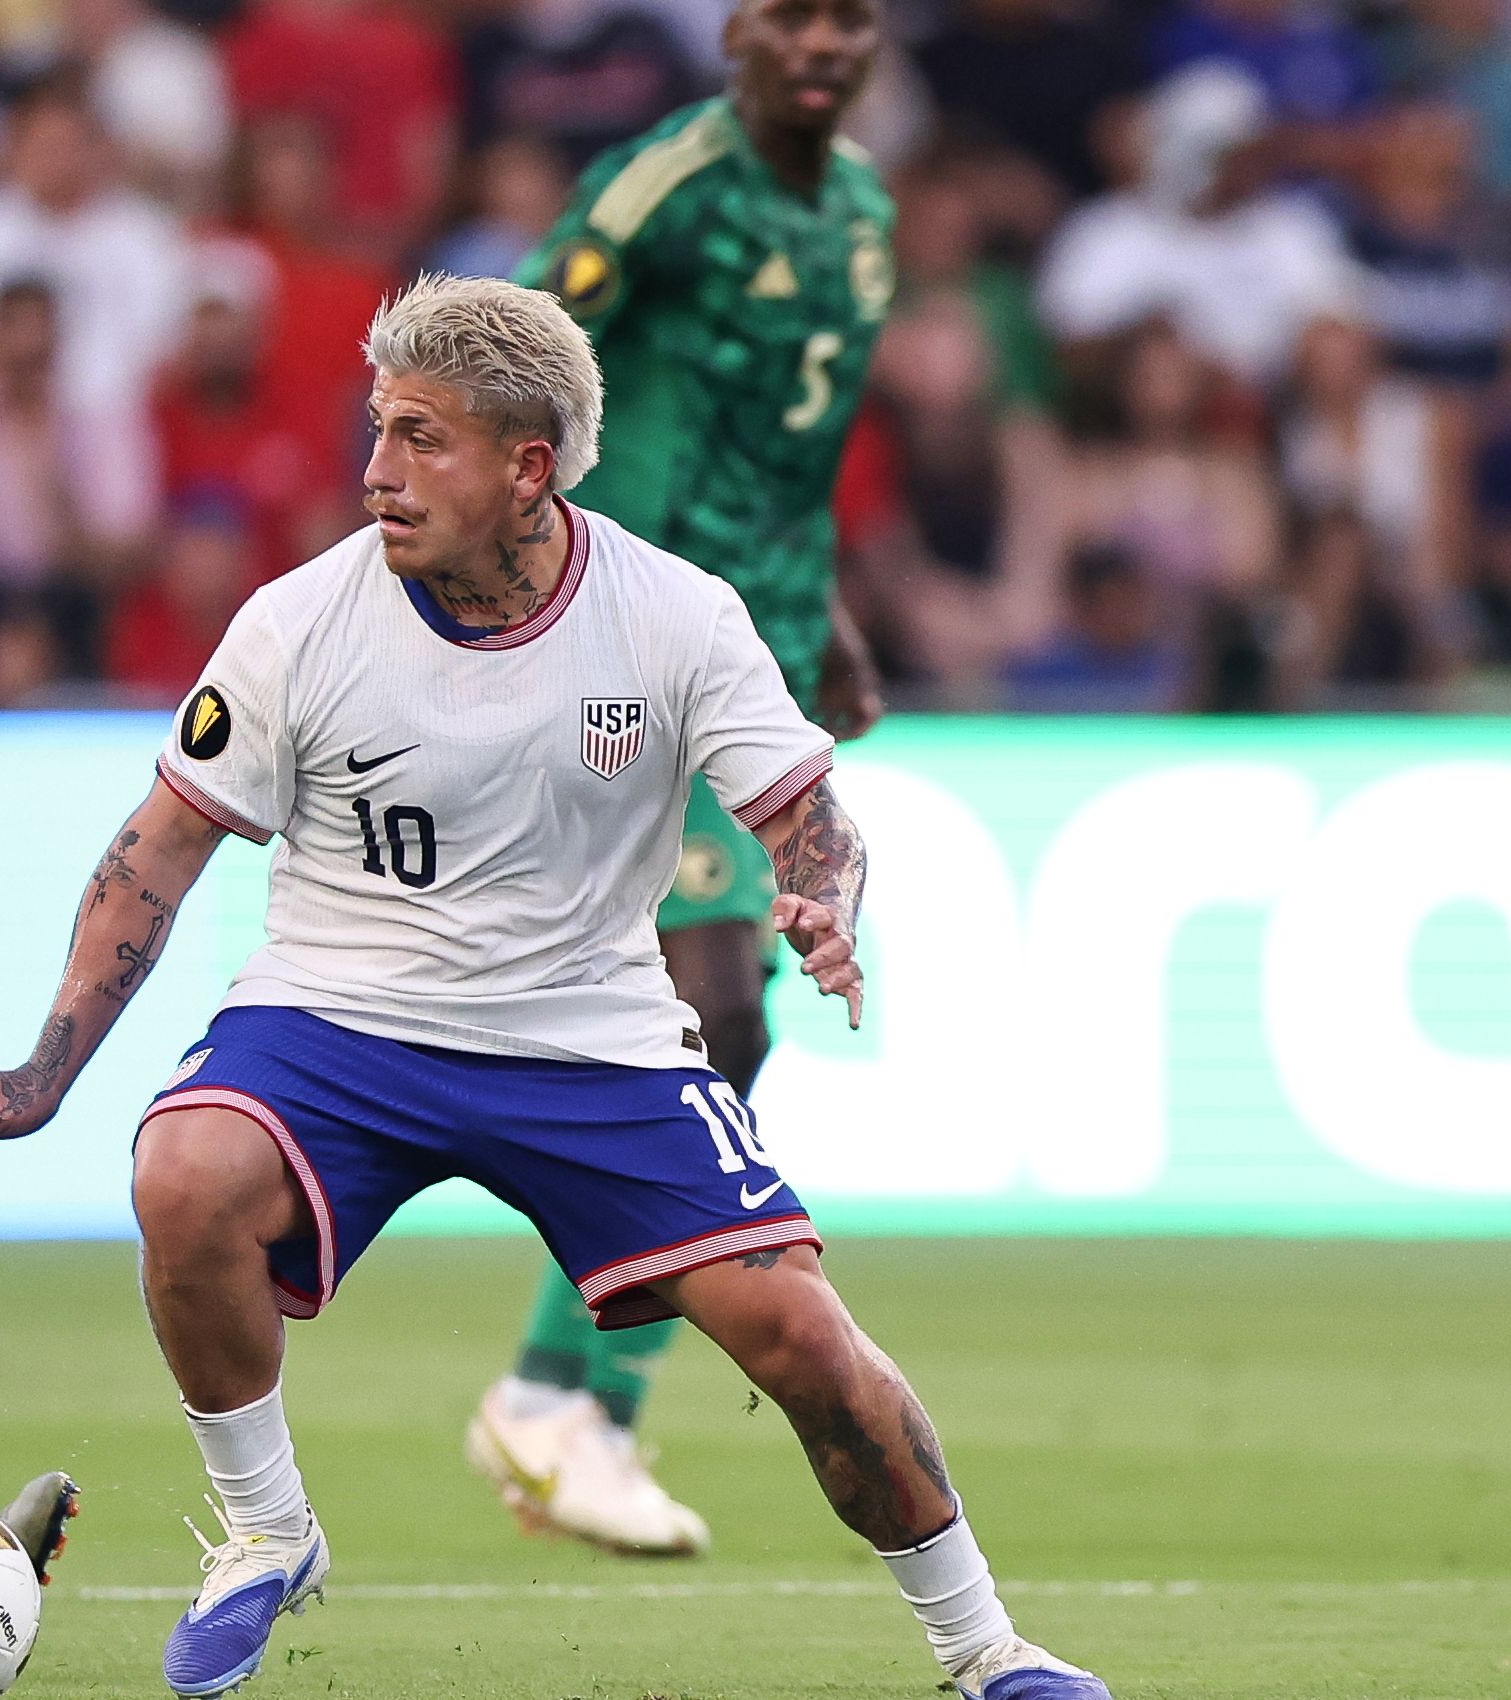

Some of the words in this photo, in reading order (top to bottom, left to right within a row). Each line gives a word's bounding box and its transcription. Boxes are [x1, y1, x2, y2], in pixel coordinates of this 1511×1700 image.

[782, 331, 843, 432] 5
[587, 703, 641, 735] USA
[352, 796, 437, 890] 10
[680, 1081, 775, 1175] 10
